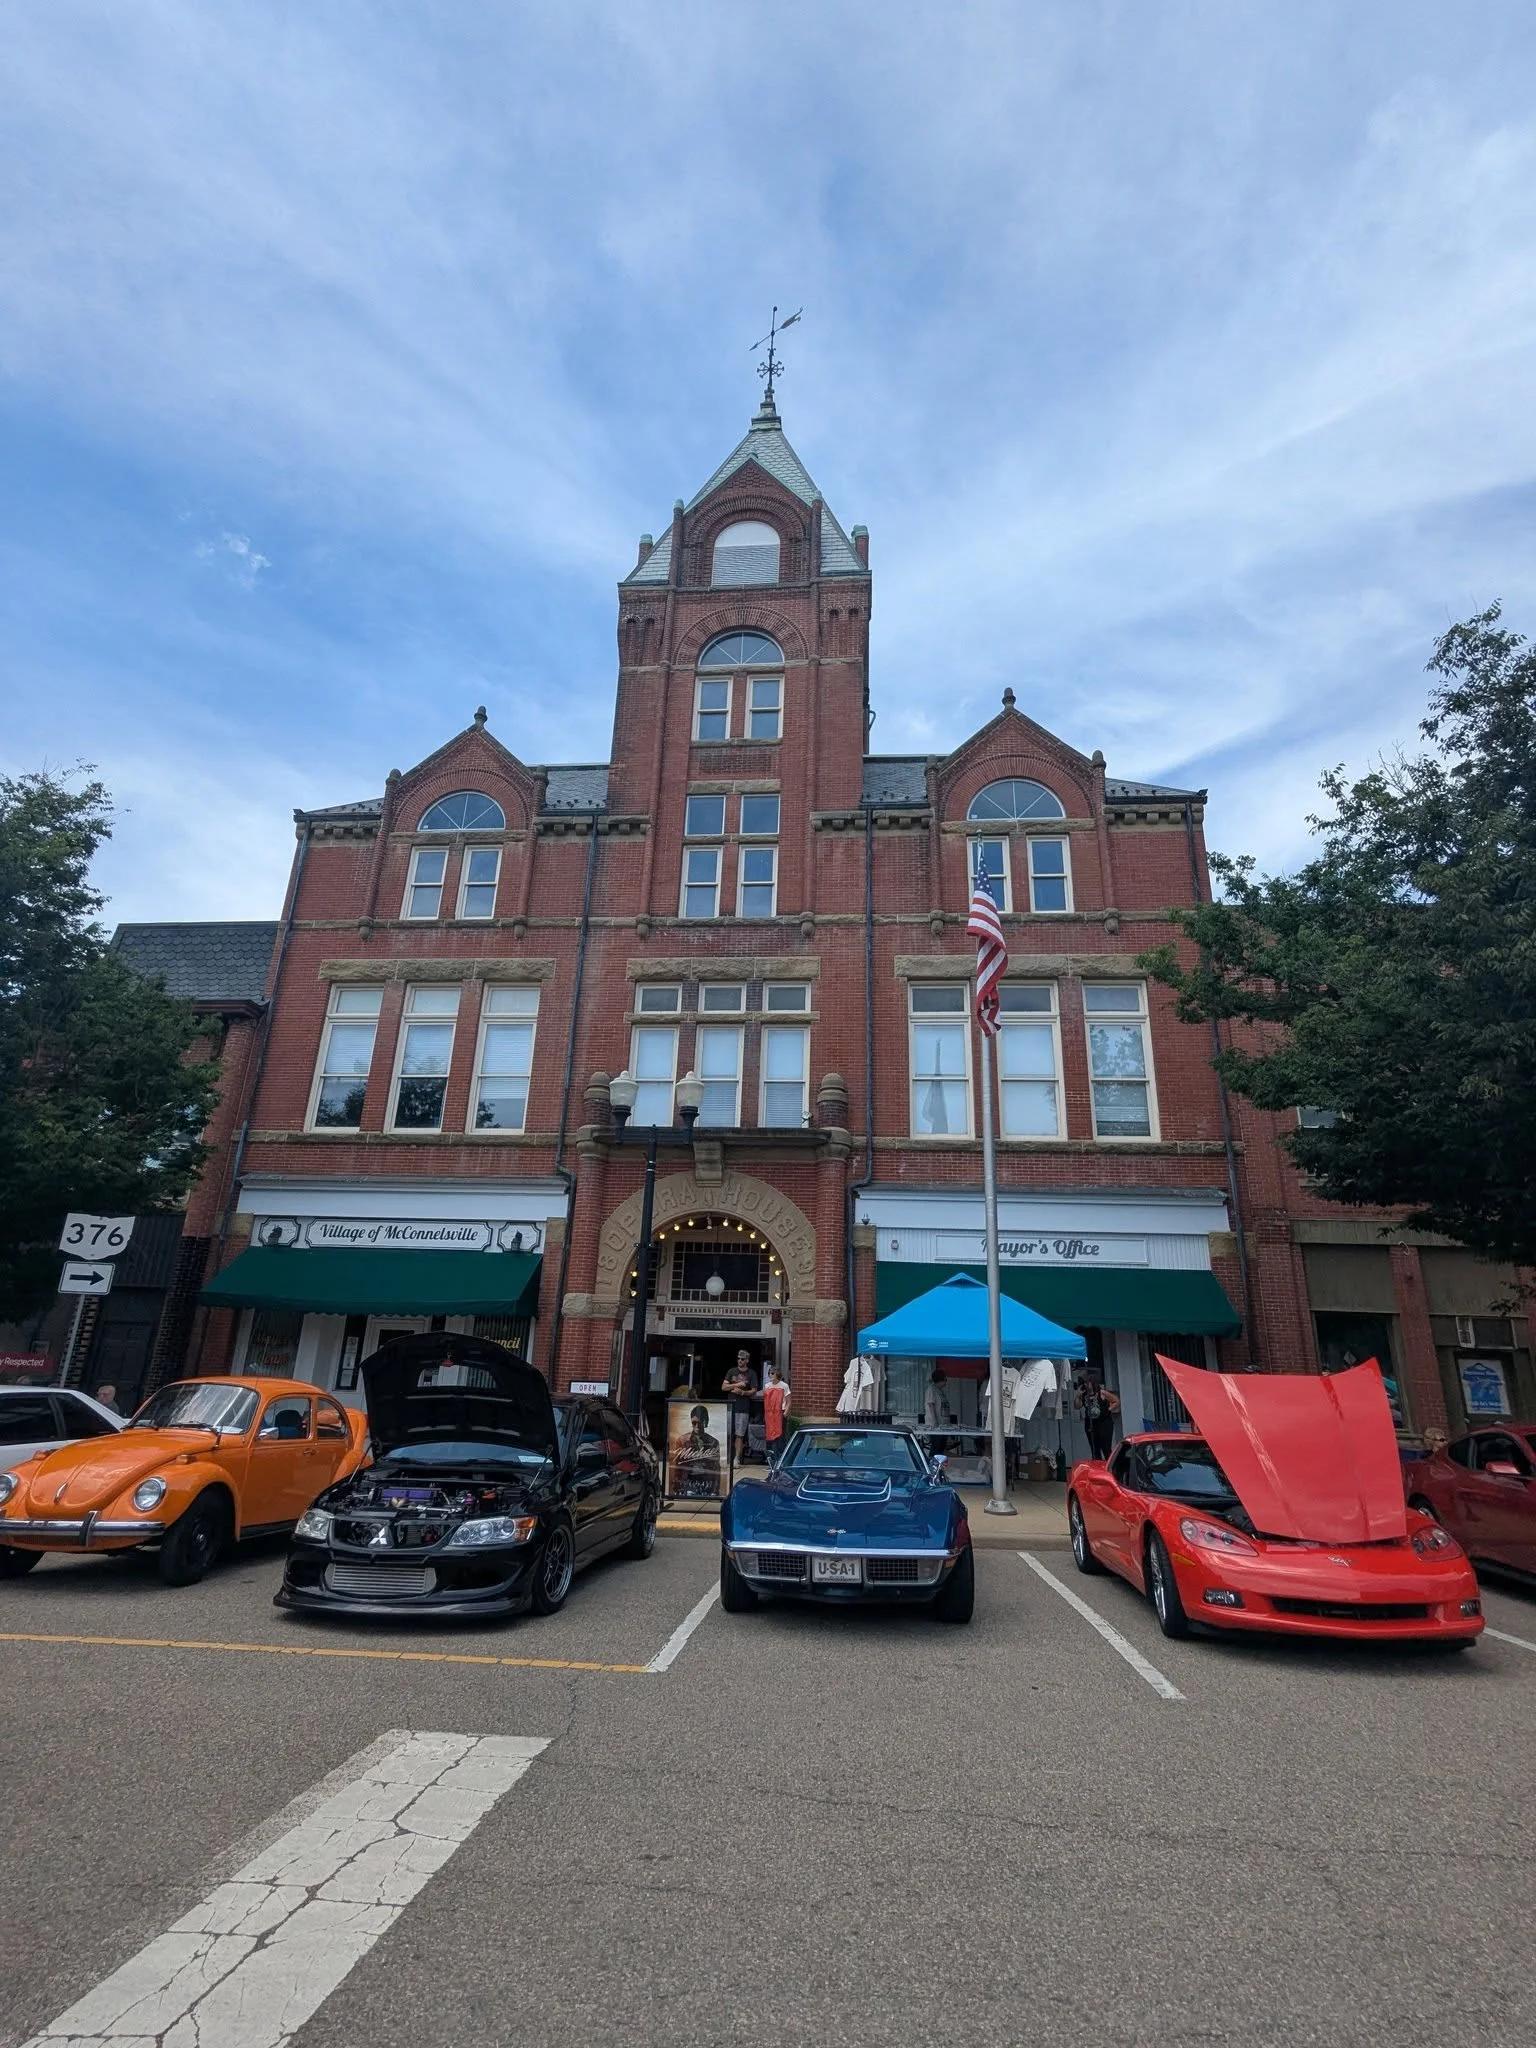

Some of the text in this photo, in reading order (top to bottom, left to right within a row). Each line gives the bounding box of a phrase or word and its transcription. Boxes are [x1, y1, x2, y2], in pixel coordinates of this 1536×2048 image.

[66, 1222, 124, 1247] 376
[320, 1223, 479, 1243] Village of McConnelsville
[1053, 1239, 1100, 1259] Office
[5, 1356, 45, 1368] Respected
[578, 1384, 597, 1393] OPEN
